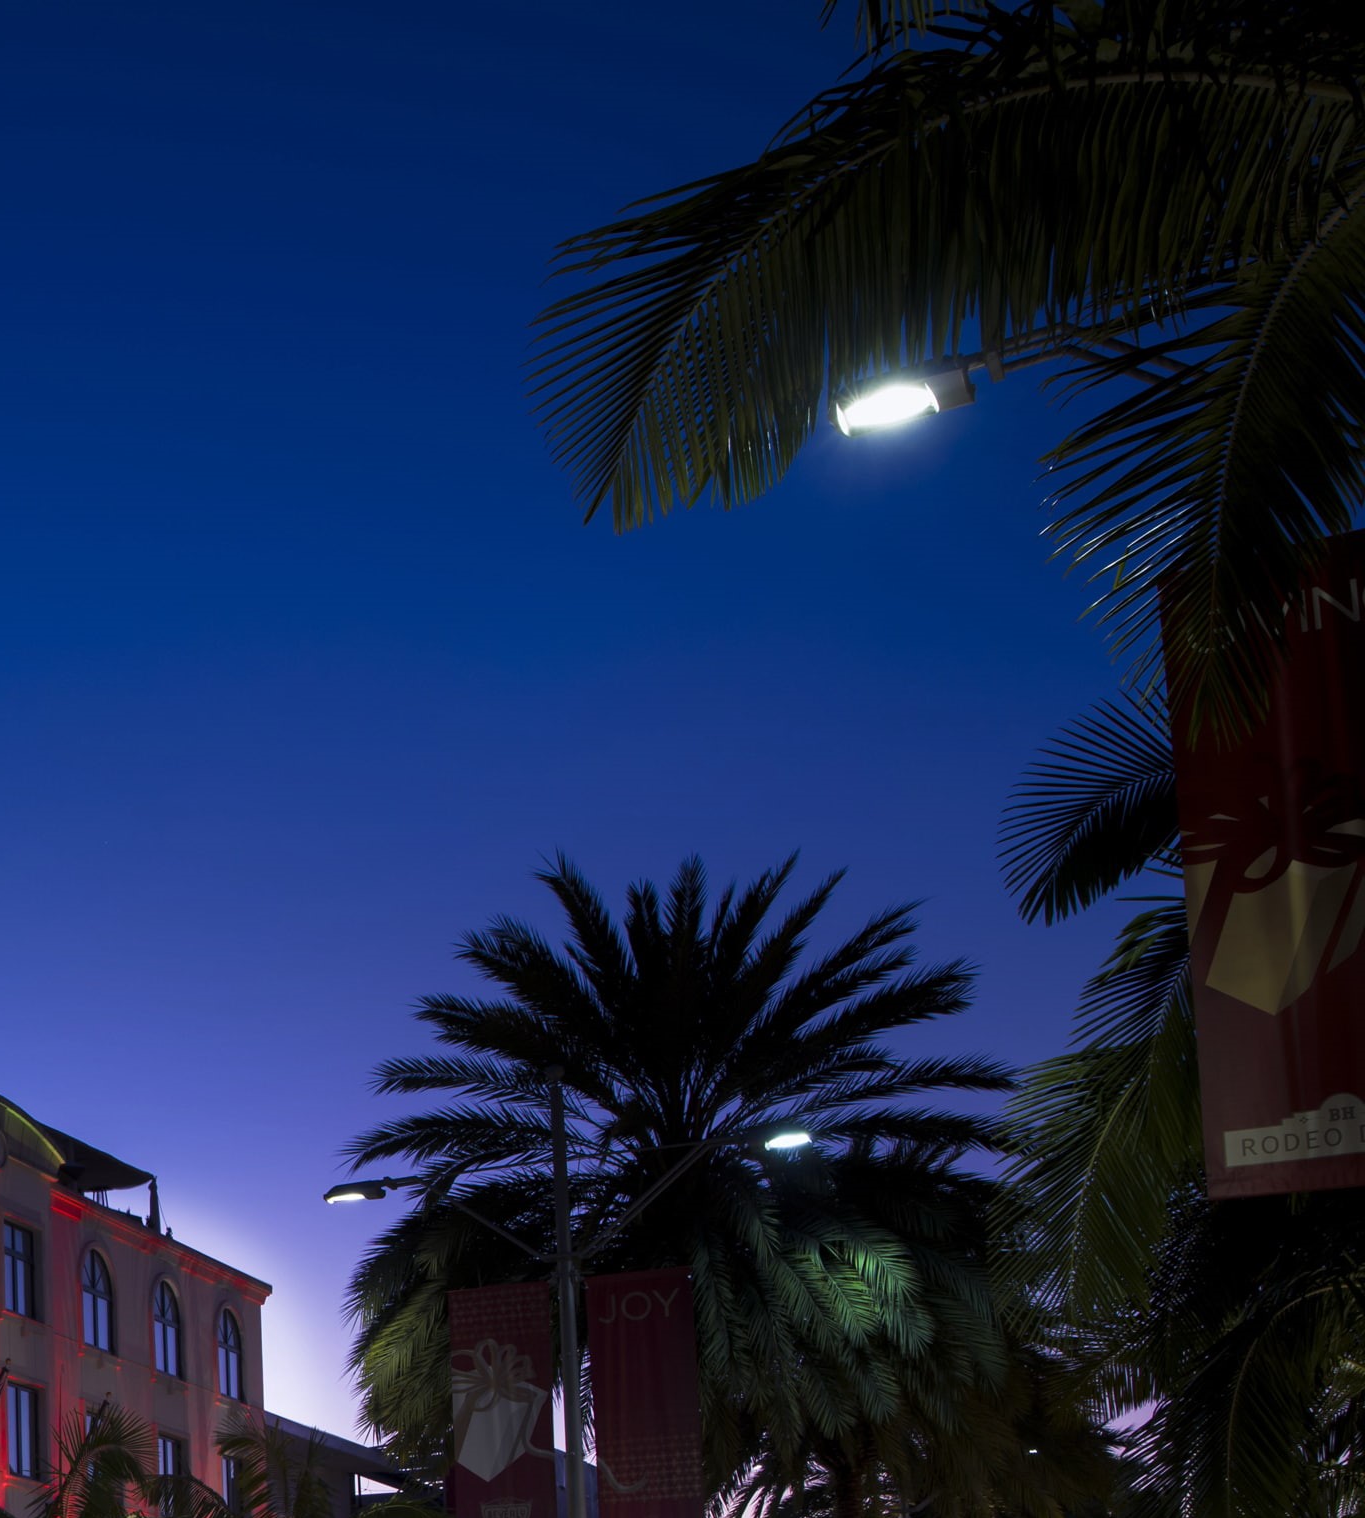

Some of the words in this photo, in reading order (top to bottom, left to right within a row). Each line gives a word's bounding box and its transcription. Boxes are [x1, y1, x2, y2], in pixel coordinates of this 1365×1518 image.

[1329, 1106, 1356, 1122] BH
[1242, 1127, 1343, 1157] RODEO
[598, 1287, 680, 1324] JOY
